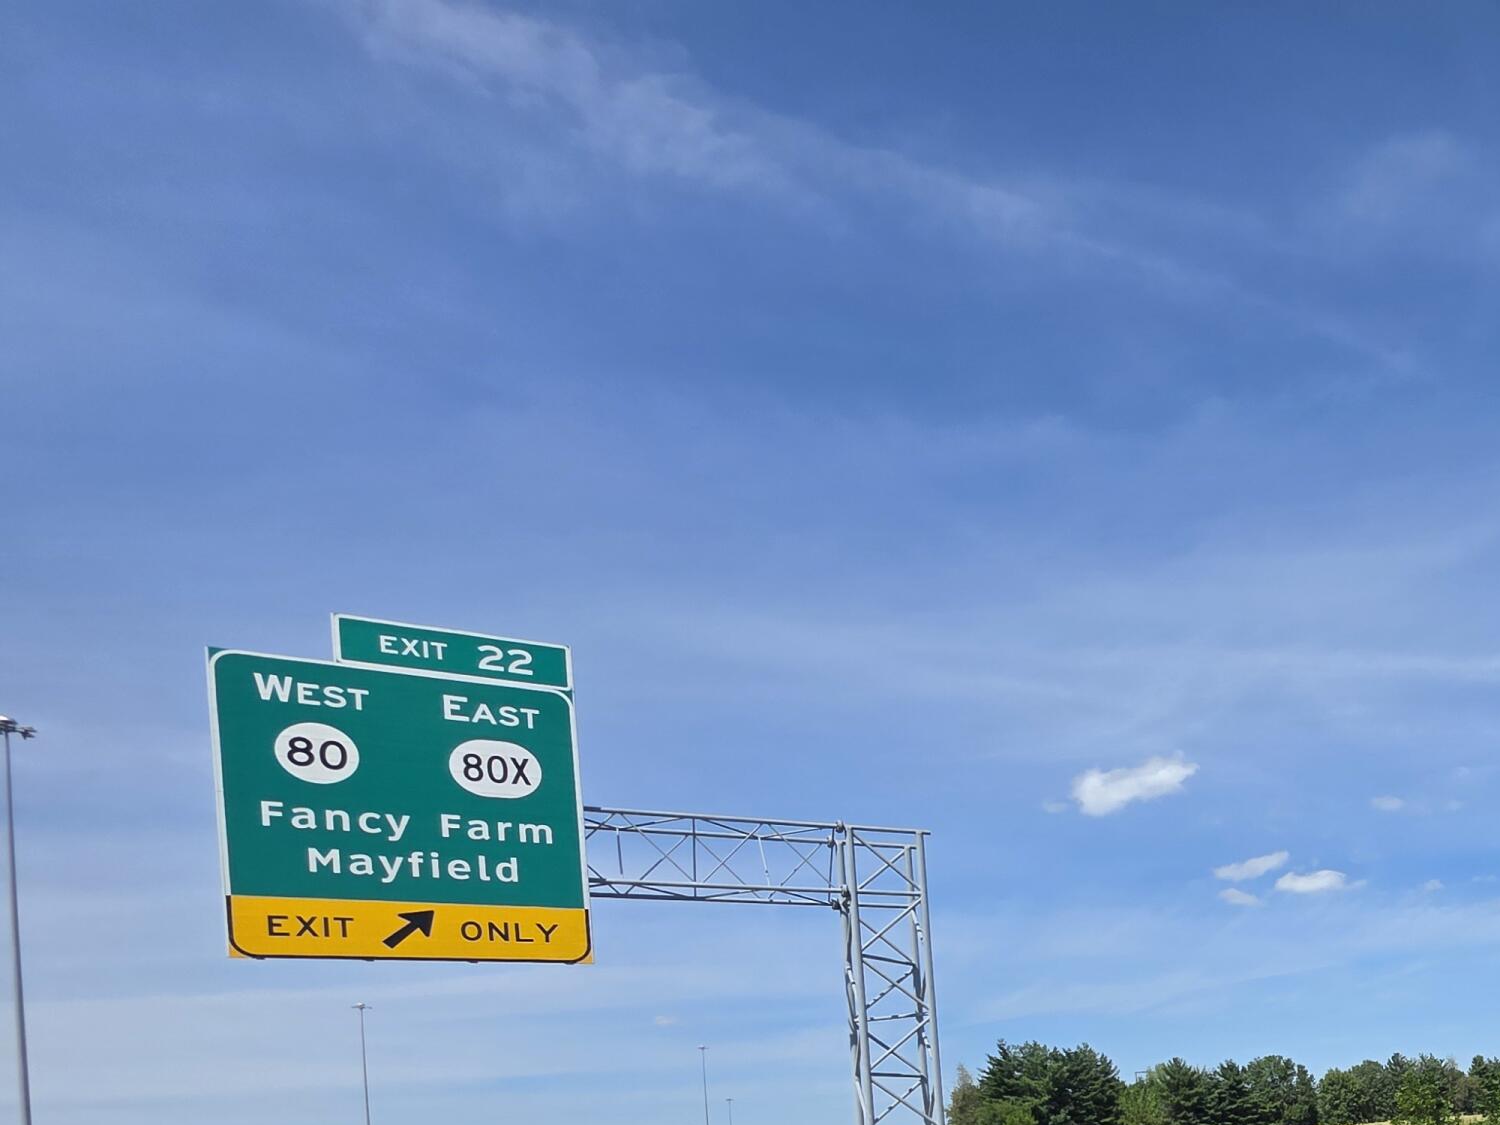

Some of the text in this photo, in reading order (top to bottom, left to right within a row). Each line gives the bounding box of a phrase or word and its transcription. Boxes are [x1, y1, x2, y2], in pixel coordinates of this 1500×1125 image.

[379, 634, 534, 676] EXIT 22
[253, 672, 369, 711] WEST
[442, 694, 540, 729] EAST
[286, 736, 348, 770] 80
[461, 753, 532, 786] 80X
[260, 800, 553, 845] Fancy Farm
[307, 847, 519, 884] Mayfield
[267, 915, 559, 944] EXIT ONLY
